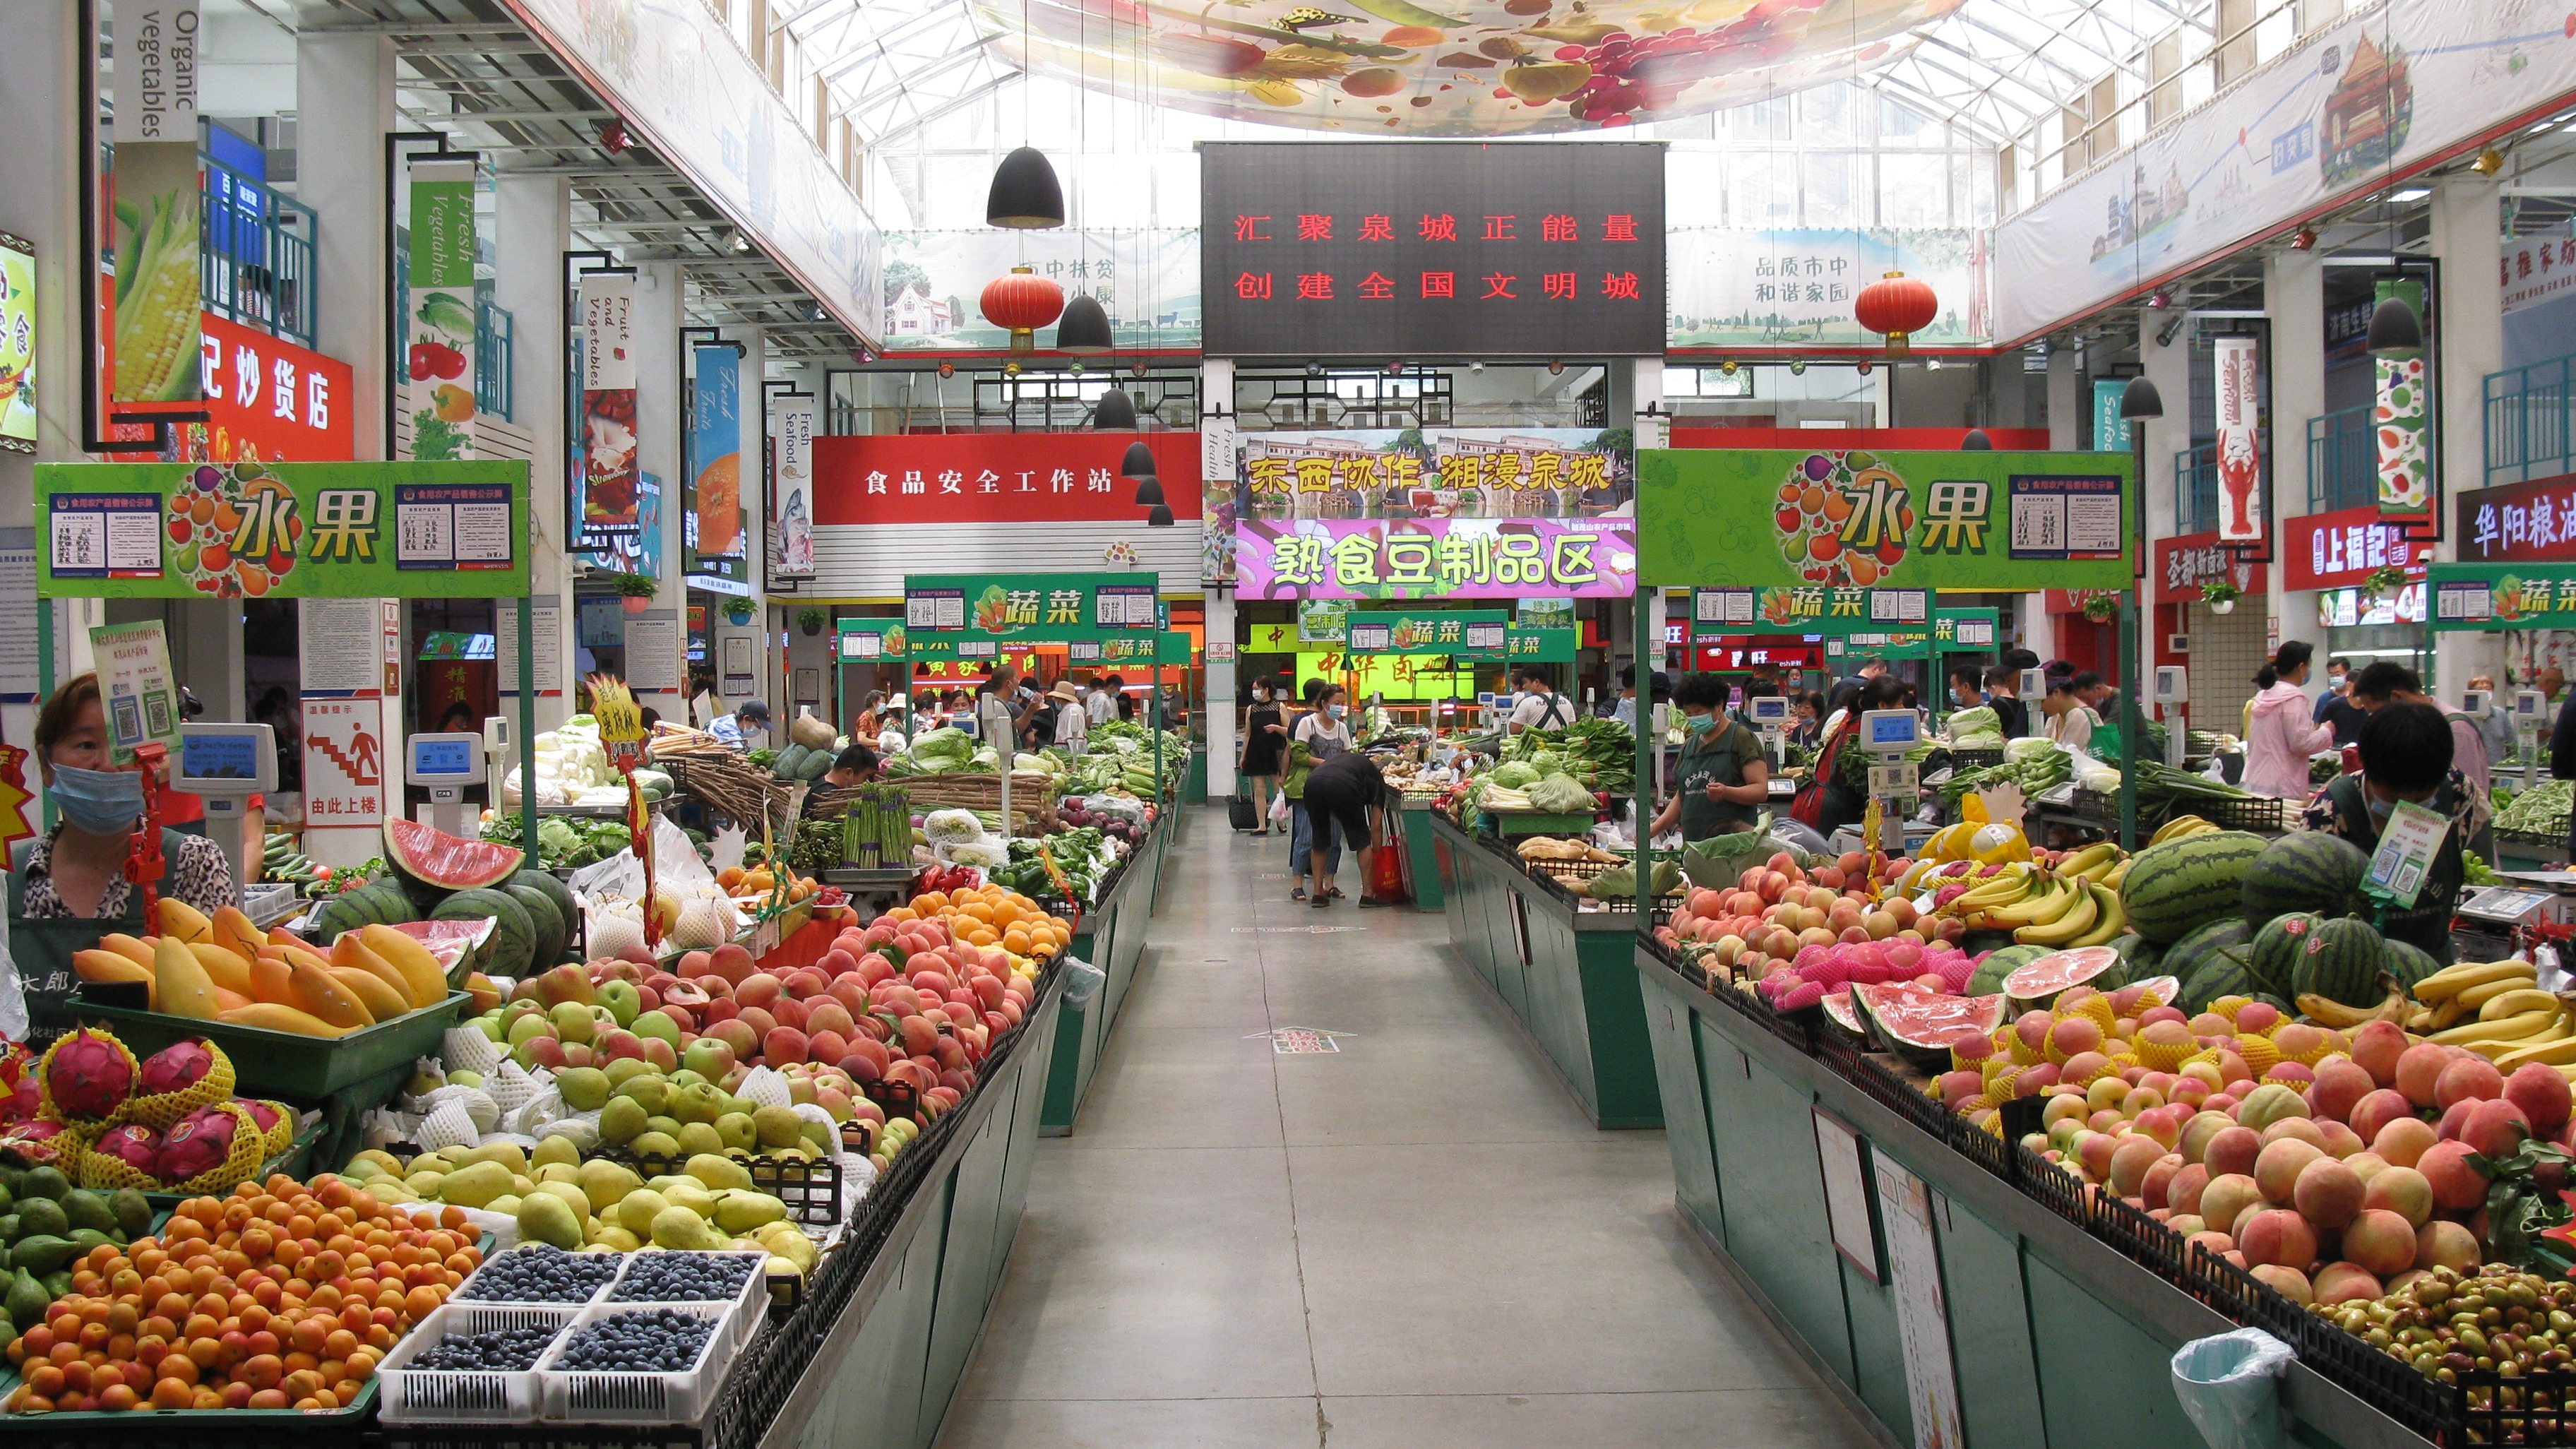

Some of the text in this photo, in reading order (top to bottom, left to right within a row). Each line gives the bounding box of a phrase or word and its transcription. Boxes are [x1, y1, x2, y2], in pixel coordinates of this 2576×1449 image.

[141, 10, 166, 138] vegetables
[175, 10, 198, 110] Organic
[431, 195, 449, 286] Vegetables
[457, 193, 475, 263] Fresh
[1234, 213, 1638, 242] 汇聚泉城正能量
[1755, 256, 1848, 278] 品质市中
[1234, 272, 1639, 300] 创建全国文明城
[1755, 282, 1849, 303] 和谐家园
[604, 297, 613, 326] and
[619, 297, 631, 340] Fruit
[588, 299, 600, 387] Vegetables
[785, 412, 797, 465] Seafood
[799, 412, 812, 446] Fresh
[1208, 431, 1220, 479] Health
[1222, 428, 1235, 469] Fresh
[864, 467, 1113, 495] 食品安全工作站
[1249, 453, 1609, 493] 东西协作 湘漫泉城
[230, 489, 380, 559] 水果
[1839, 478, 1991, 554] 水果
[1274, 533, 1599, 585] 熟食豆制品区
[1004, 589, 1083, 625] 蔬菜
[1789, 587, 1864, 616] 蔬菜
[1412, 620, 1462, 643] 蔬菜
[1936, 618, 1955, 640] 菜
[1117, 639, 1155, 657] 蔬菜
[309, 705, 352, 715] 温馨提示
[311, 796, 376, 814] 由此上楼
